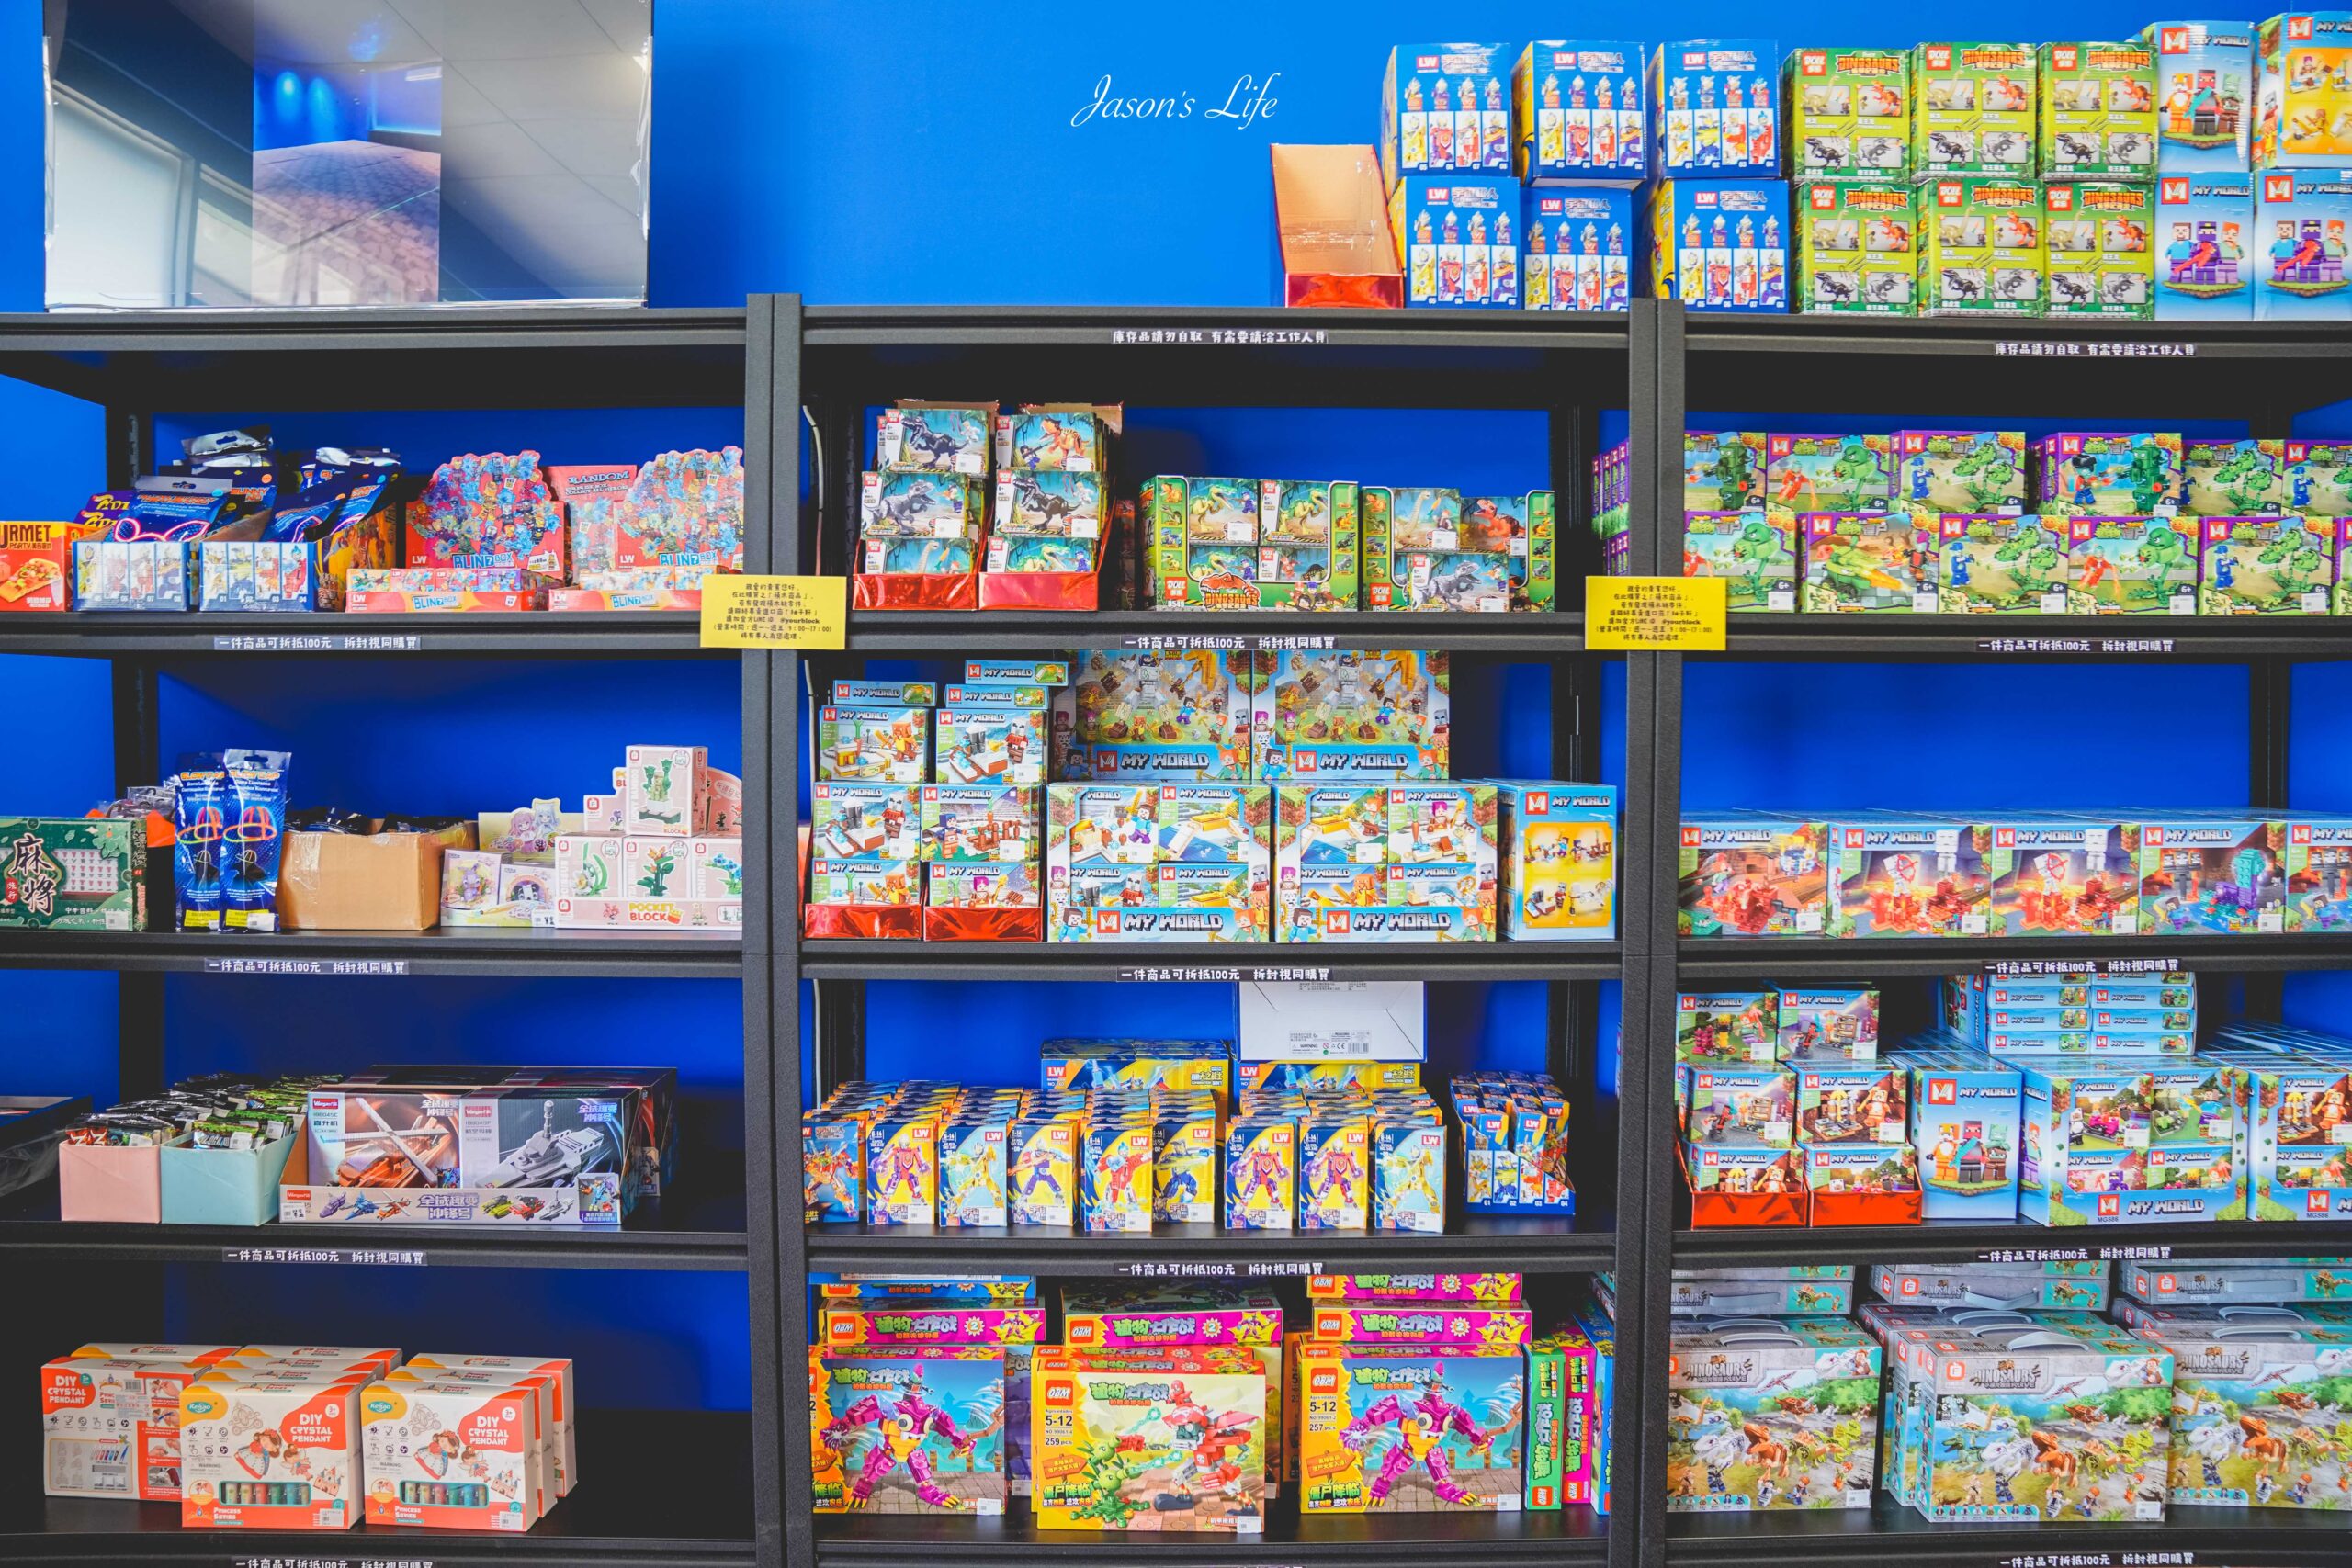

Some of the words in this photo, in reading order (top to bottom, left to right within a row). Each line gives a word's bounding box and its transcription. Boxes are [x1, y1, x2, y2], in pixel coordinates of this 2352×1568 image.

[1113, 330, 1202, 343] 庫存品請勿自取
[1995, 343, 2079, 355] 庫存品請勿自取
[568, 470, 630, 485] RANDOM
[219, 637, 332, 649] 一件商品可折抵100元
[345, 637, 416, 649] 拆封視同購買
[1125, 637, 1245, 649] 一件商品可折抵100元
[1258, 637, 1335, 649] 拆封視同購買
[1979, 640, 2090, 652] 一件商品可折抵100元
[2102, 639, 2173, 651] 拆封視同購買
[984, 668, 1000, 677] MY
[1001, 668, 1033, 677] WORLD
[965, 692, 979, 701] MY
[980, 692, 1012, 701] WORLD
[840, 710, 854, 720] MY
[856, 711, 889, 721] WORLD
[1121, 752, 1149, 770] MY
[1152, 752, 1210, 771] WORLD
[1319, 753, 1349, 770] MY
[1351, 753, 1409, 771] WORLD
[1551, 796, 1570, 807] MY
[1571, 795, 1611, 807] WORLD
[1702, 829, 1725, 842] MY
[1727, 829, 1772, 842] WORLD
[1866, 832, 1889, 844] MY
[1891, 831, 1936, 844] WORLD
[2017, 829, 2040, 843] MY
[2041, 829, 2085, 843] WORLD
[2165, 829, 2186, 841] MY
[2188, 828, 2233, 841] WORLD
[831, 863, 846, 873] MY
[848, 863, 882, 874] WORLD
[949, 866, 965, 875] MY
[967, 866, 1001, 876] WORLD
[628, 902, 675, 913] POCKET
[630, 912, 668, 922] BLOCK
[1124, 913, 1157, 931] MY
[1159, 913, 1225, 932] WORLD
[1353, 913, 1386, 931] MY
[1388, 913, 1452, 931] WORLD
[209, 960, 321, 972] 一件商品可折抵100元
[334, 961, 405, 974] 拆封視同購買
[1985, 962, 2096, 974] 一件商品可折抵100元
[2108, 959, 2178, 972] 拆封視同購買
[1121, 968, 1240, 980] 一件商品可折抵100元
[1253, 968, 1329, 980] 拆封視同購買
[1048, 1066, 1064, 1077] LW
[1241, 1067, 1259, 1077] LW
[1959, 1087, 1979, 1098] MY
[1980, 1086, 2018, 1098] WORLD
[1487, 1121, 1501, 1129] LW
[1526, 1121, 1539, 1129] LW
[914, 1128, 930, 1138] LW
[987, 1133, 1001, 1141] LW
[1274, 1134, 1289, 1144] LW
[1349, 1134, 1363, 1143] LW
[1133, 1136, 1148, 1146] LW
[2127, 1200, 2153, 1216] MY
[2154, 1199, 2205, 1214] WORLD
[228, 1249, 339, 1262] 一件商品可折抵100元
[352, 1250, 423, 1264] 拆封視同購買
[1979, 1248, 2088, 1261] 一件商品可折抵100元
[2100, 1246, 2171, 1258] 拆封視同購買
[1118, 1262, 1236, 1275] 一件商品可折抵100元
[1249, 1262, 1323, 1275] 拆封視同購買
[55, 1375, 78, 1387] DIY
[47, 1387, 86, 1396] CRYSTAL
[1309, 1401, 1337, 1413] 5-12
[300, 1413, 323, 1426] DIY
[477, 1416, 500, 1427] DIY
[1045, 1415, 1073, 1427] 5-12
[290, 1426, 333, 1436] CRYSTAL
[468, 1428, 510, 1438] CRYSTAL
[1309, 1423, 1324, 1432] 257
[469, 1438, 508, 1446] PENDANT
[1045, 1438, 1060, 1446] 259
[2000, 1554, 2110, 1567] 一件商品可折抵100元
[2122, 1552, 2194, 1564] 拆封視同購買
